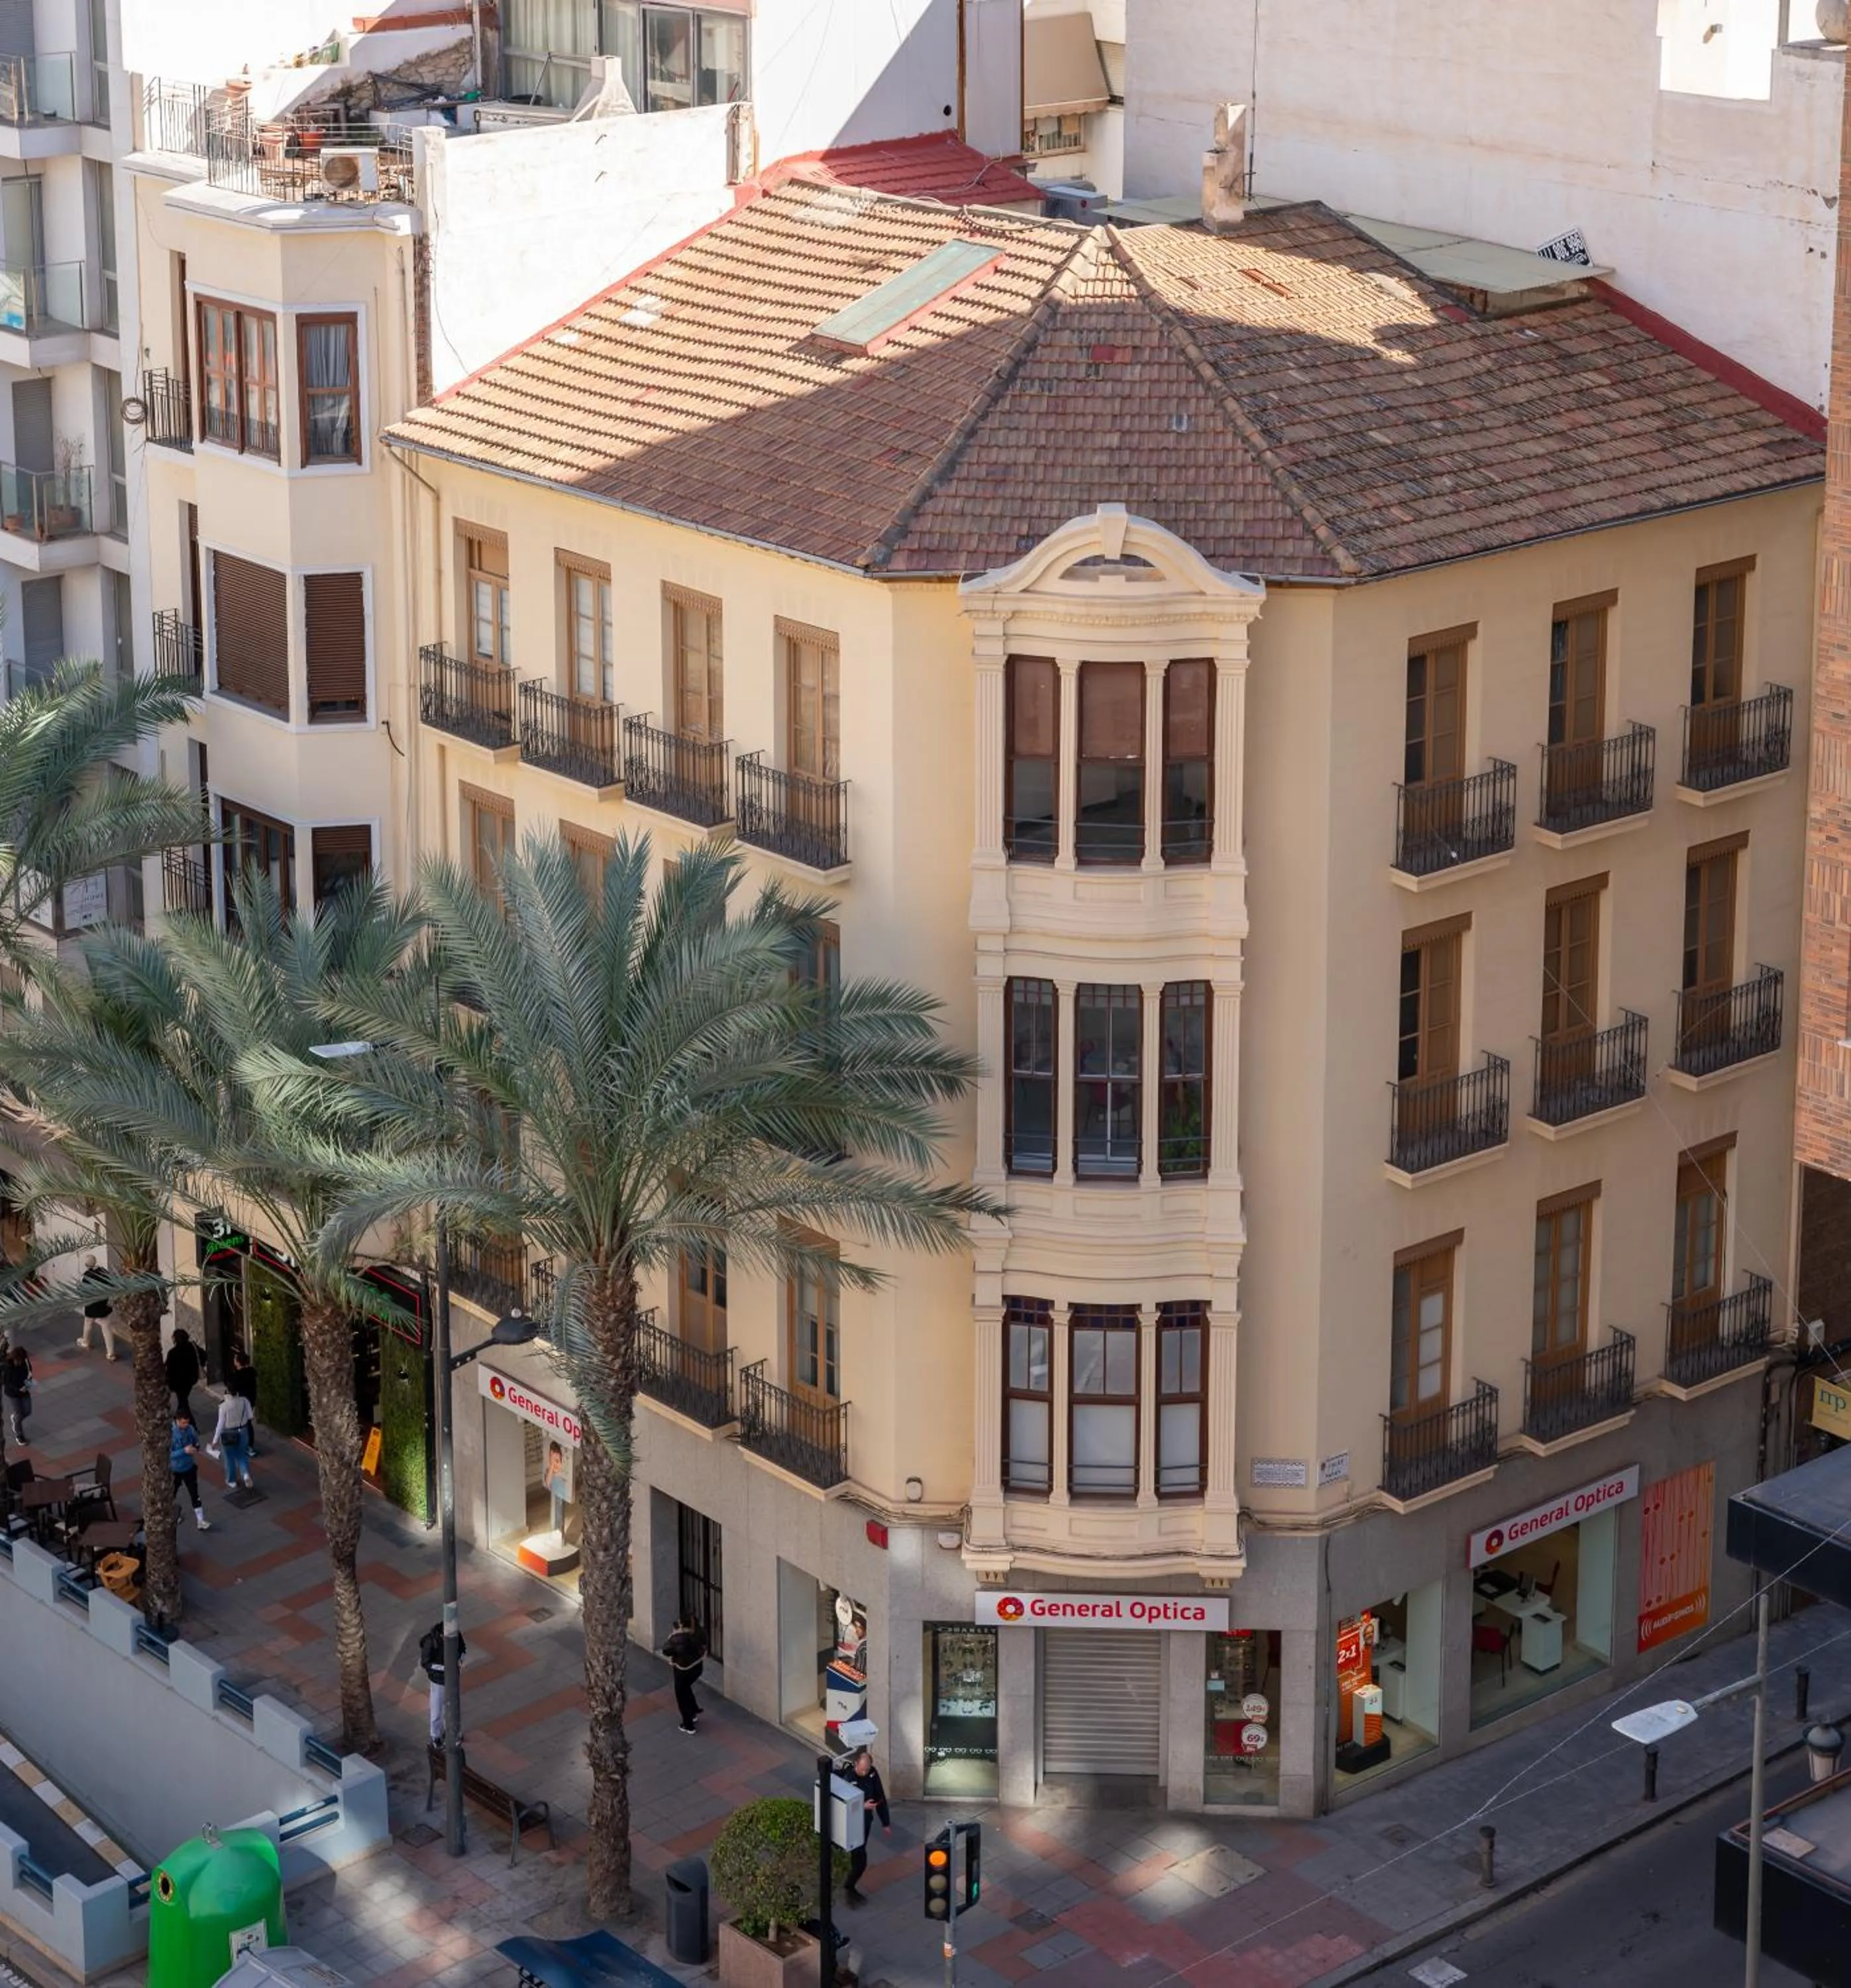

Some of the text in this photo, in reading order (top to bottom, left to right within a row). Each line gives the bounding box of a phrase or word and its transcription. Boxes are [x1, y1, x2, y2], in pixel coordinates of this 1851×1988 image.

[507, 1386, 560, 1428] General
[1508, 1480, 1624, 1541] General Optica
[1030, 1599, 1206, 1624] General Optica
